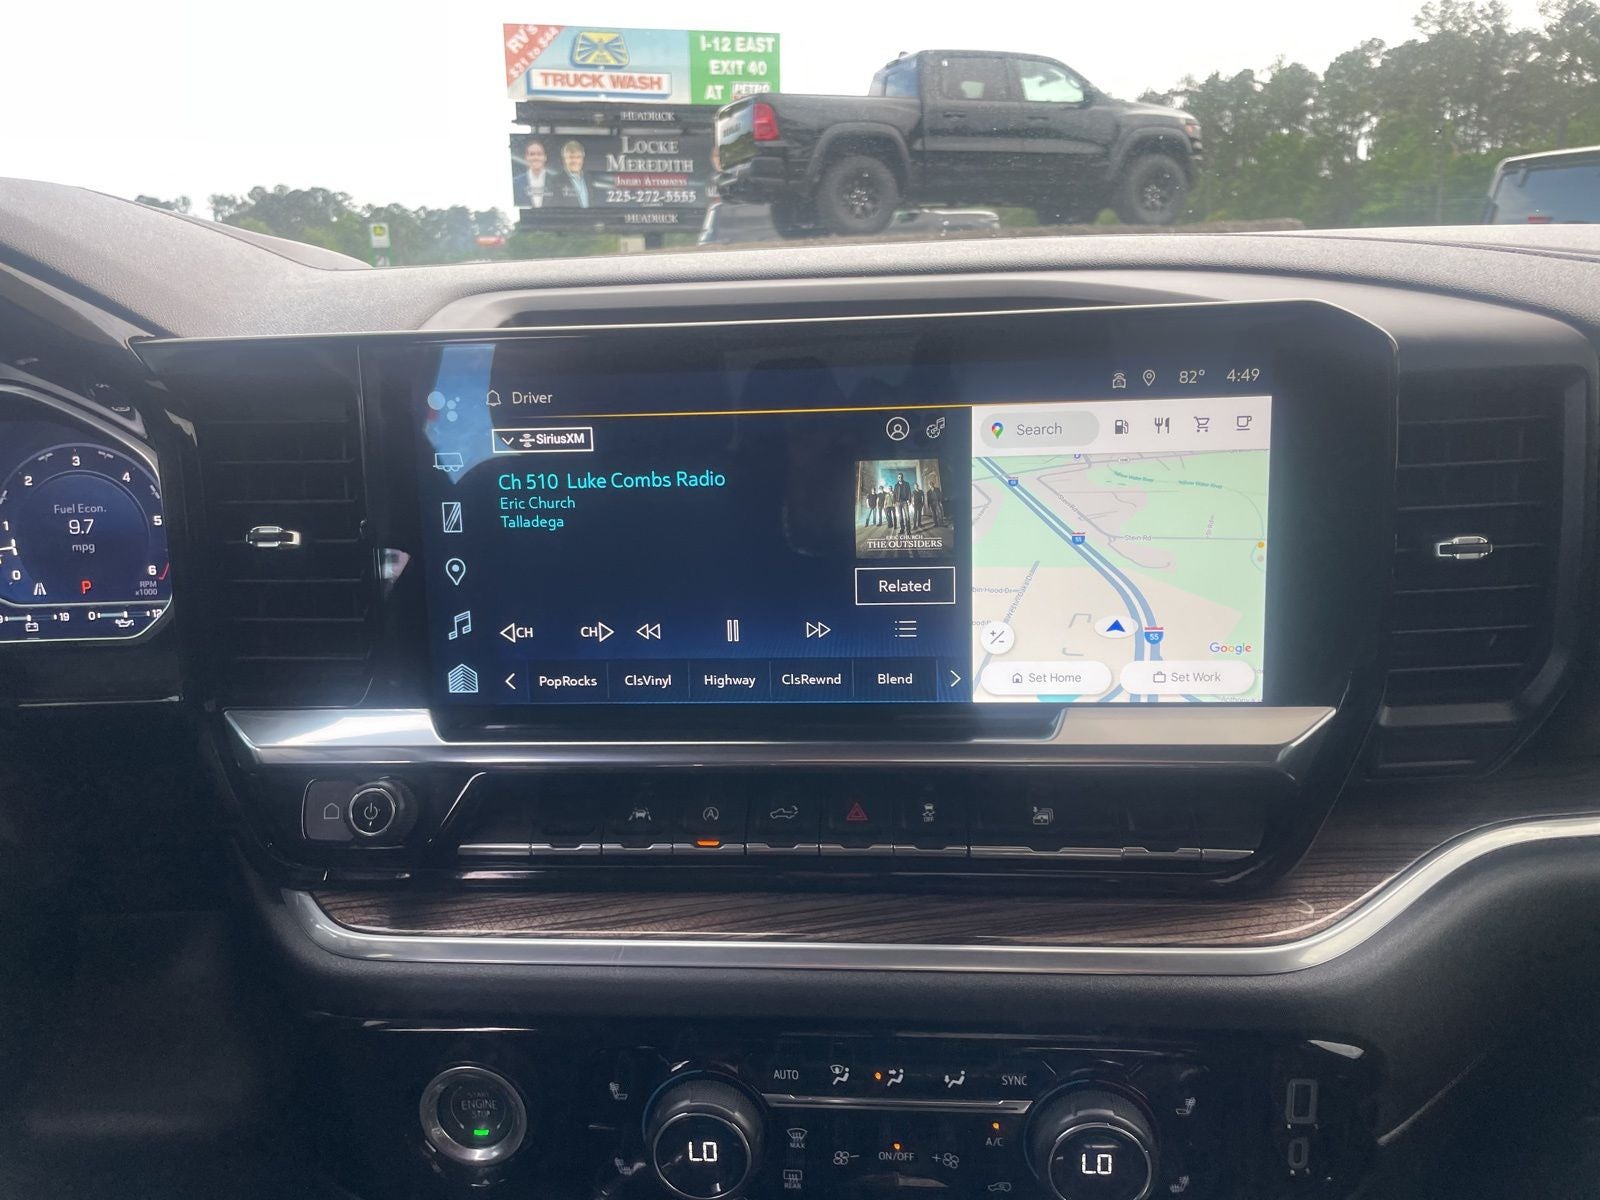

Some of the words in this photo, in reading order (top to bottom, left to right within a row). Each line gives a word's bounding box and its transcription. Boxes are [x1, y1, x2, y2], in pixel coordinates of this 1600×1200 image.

[699, 34, 731, 52] I-12
[735, 36, 775, 53] EAST
[708, 59, 745, 76] EXIT
[747, 60, 768, 76] 40
[540, 71, 605, 89] TRUCK
[609, 73, 663, 91] WASH
[704, 84, 724, 100] AT
[605, 190, 697, 203] 225-272-5555
[1227, 367, 1261, 383] 4:49
[512, 391, 553, 405] Driver
[1016, 420, 1063, 437] Search
[536, 433, 585, 446] SiriusXM
[72, 456, 81, 466] 3
[24, 476, 33, 487] 2
[122, 472, 131, 483] 4
[498, 474, 522, 491] Ch
[526, 473, 559, 490] 510
[567, 472, 607, 489] Luke
[610, 470, 672, 488] Combs
[677, 470, 726, 487] Radio
[53, 504, 76, 514] Fuel
[78, 503, 107, 514] Econ.
[500, 497, 526, 510] Eric
[528, 496, 576, 510] Church
[3, 521, 10, 531] 1
[69, 519, 94, 535] 9.7
[153, 515, 163, 526] 5
[500, 515, 565, 531] Talladega
[72, 542, 96, 555] mpg
[867, 541, 887, 549] THE
[888, 539, 943, 549] OUTSIDERS
[12, 570, 21, 581] 0
[148, 565, 157, 576] 6
[82, 581, 92, 594] P
[140, 581, 157, 589] RPM
[878, 579, 931, 593] Related
[59, 612, 70, 622] 19
[88, 611, 96, 621] 0
[516, 627, 534, 639] CH
[580, 626, 598, 638] CH
[1209, 641, 1252, 655] Google
[539, 674, 598, 689] PopRocks
[624, 674, 672, 689] ClsVinyl
[704, 673, 756, 688] Highway
[781, 673, 842, 686] ClsRewnd
[877, 672, 913, 685] Blend
[1028, 672, 1047, 683] Set
[1050, 673, 1082, 683] Home
[1171, 672, 1190, 682] Set
[1193, 671, 1221, 682] Work
[773, 1069, 799, 1081] AUTO
[1001, 1075, 1028, 1087] SYNC
[461, 1099, 498, 1111] ENGINE
[789, 1142, 806, 1150] MAX
[985, 1136, 1005, 1147] A/C
[688, 1141, 718, 1162] LO
[878, 1151, 915, 1162] ON/OFF
[1081, 1153, 1113, 1175] LO
[783, 1181, 802, 1190] REAR
